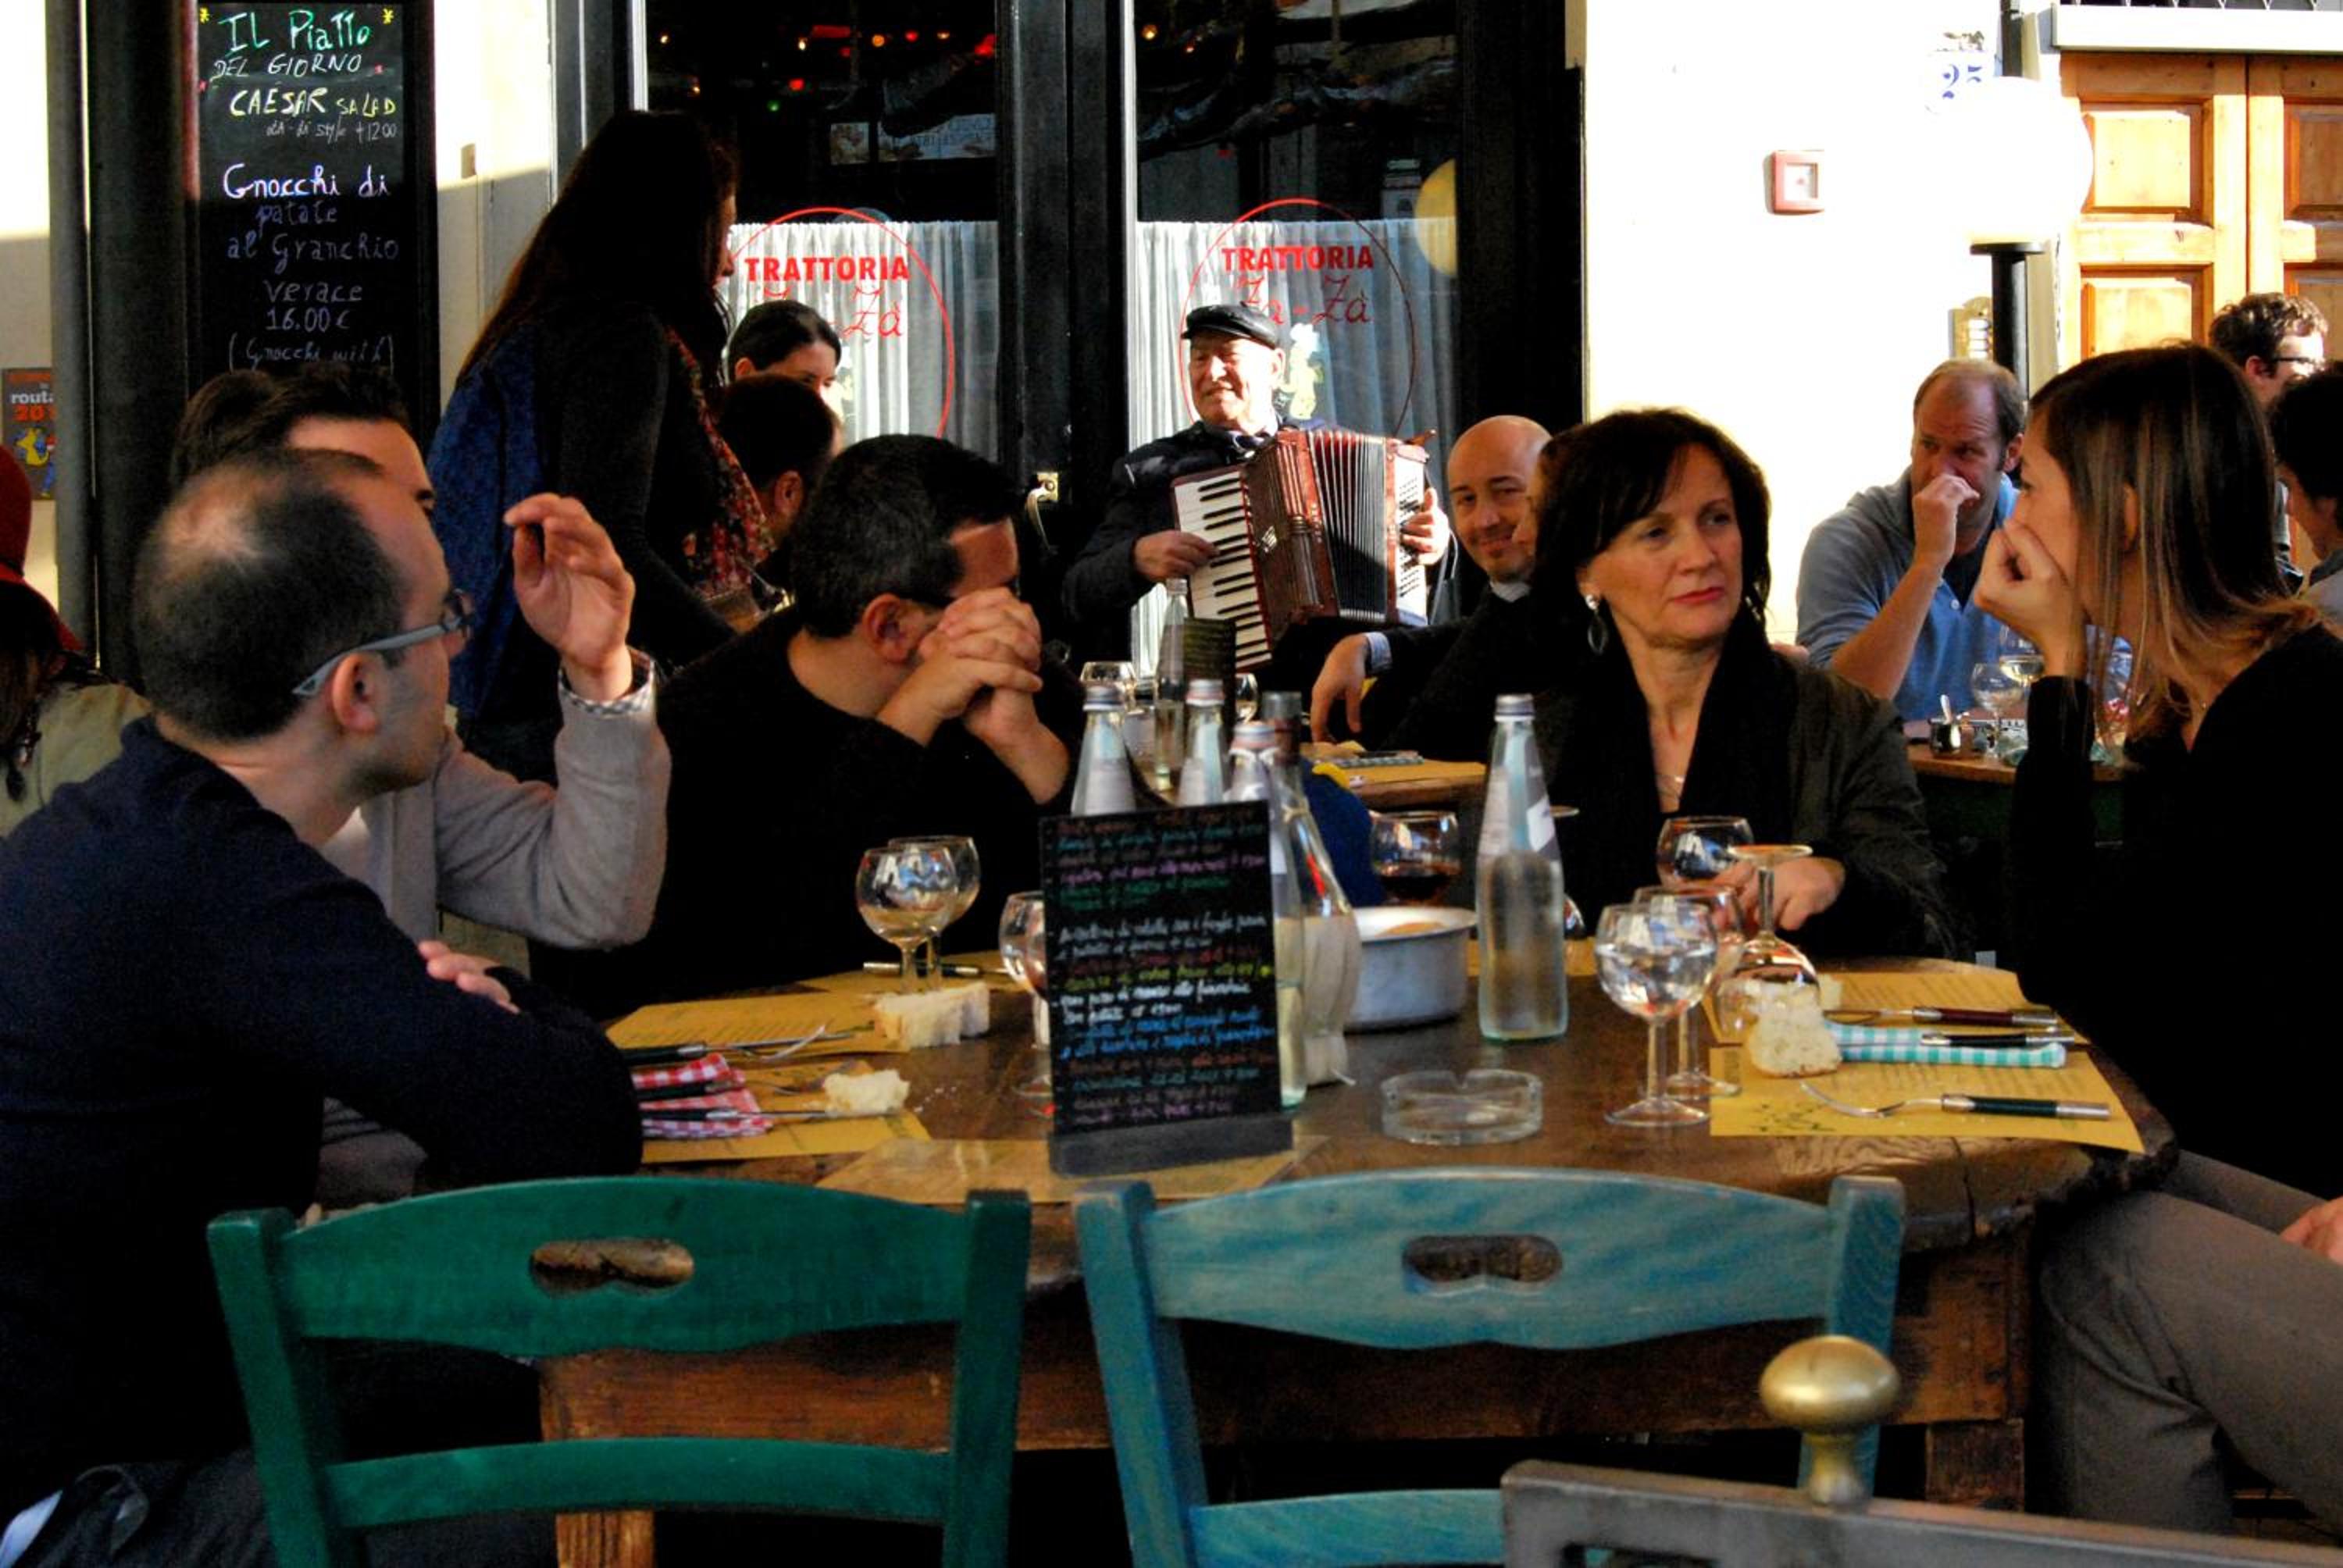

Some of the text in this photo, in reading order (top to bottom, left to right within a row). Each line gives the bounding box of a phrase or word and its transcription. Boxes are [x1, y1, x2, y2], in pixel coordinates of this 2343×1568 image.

[211, 52, 362, 78] DEL GIORNO
[223, 162, 390, 199] Gnocchi di
[255, 198, 338, 238] patate
[226, 229, 258, 260] al
[1221, 244, 1375, 271] TRATTORIA
[744, 255, 912, 283] TRATTORIA
